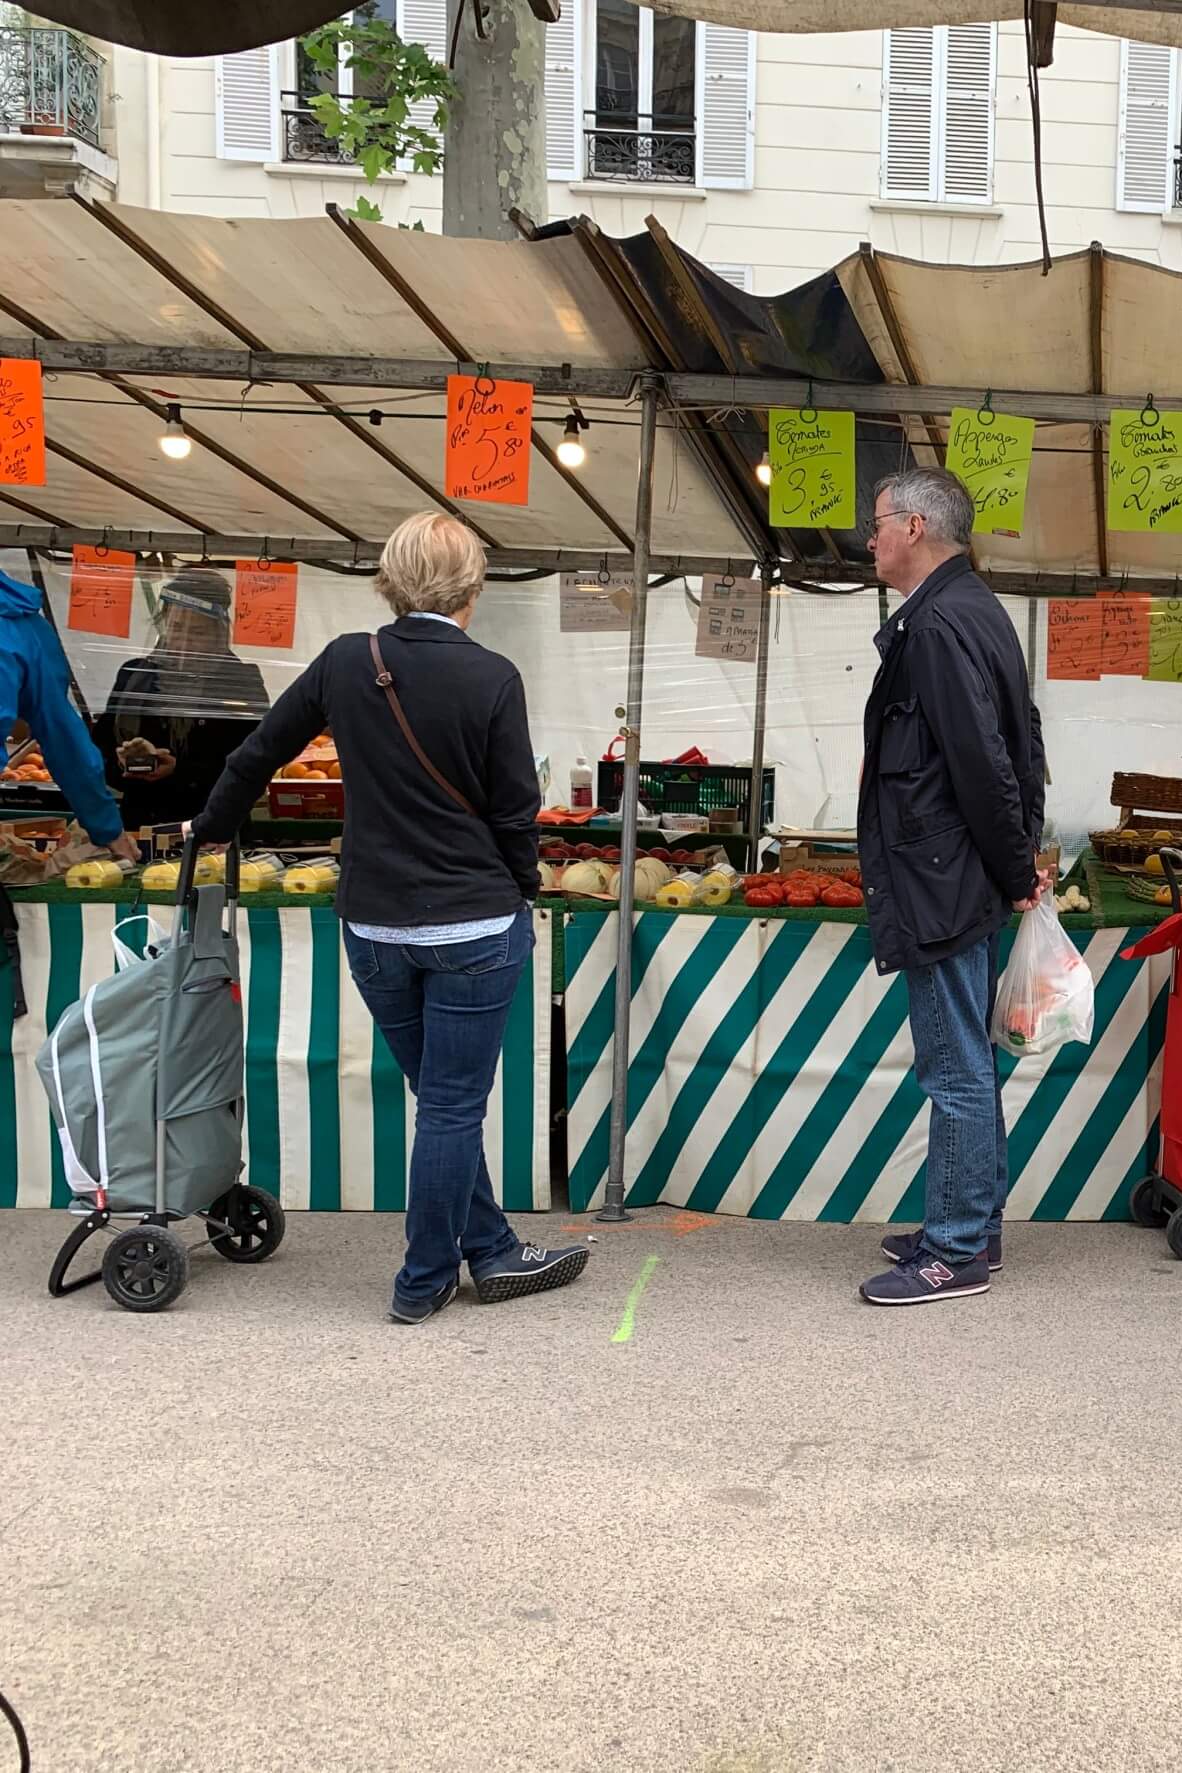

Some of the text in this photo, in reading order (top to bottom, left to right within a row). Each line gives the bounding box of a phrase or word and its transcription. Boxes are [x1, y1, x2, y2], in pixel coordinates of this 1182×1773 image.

[472, 426, 501, 480] 5
[1123, 466, 1150, 510] 2
[521, 1247, 547, 1262] N
[919, 1261, 954, 1289] N
